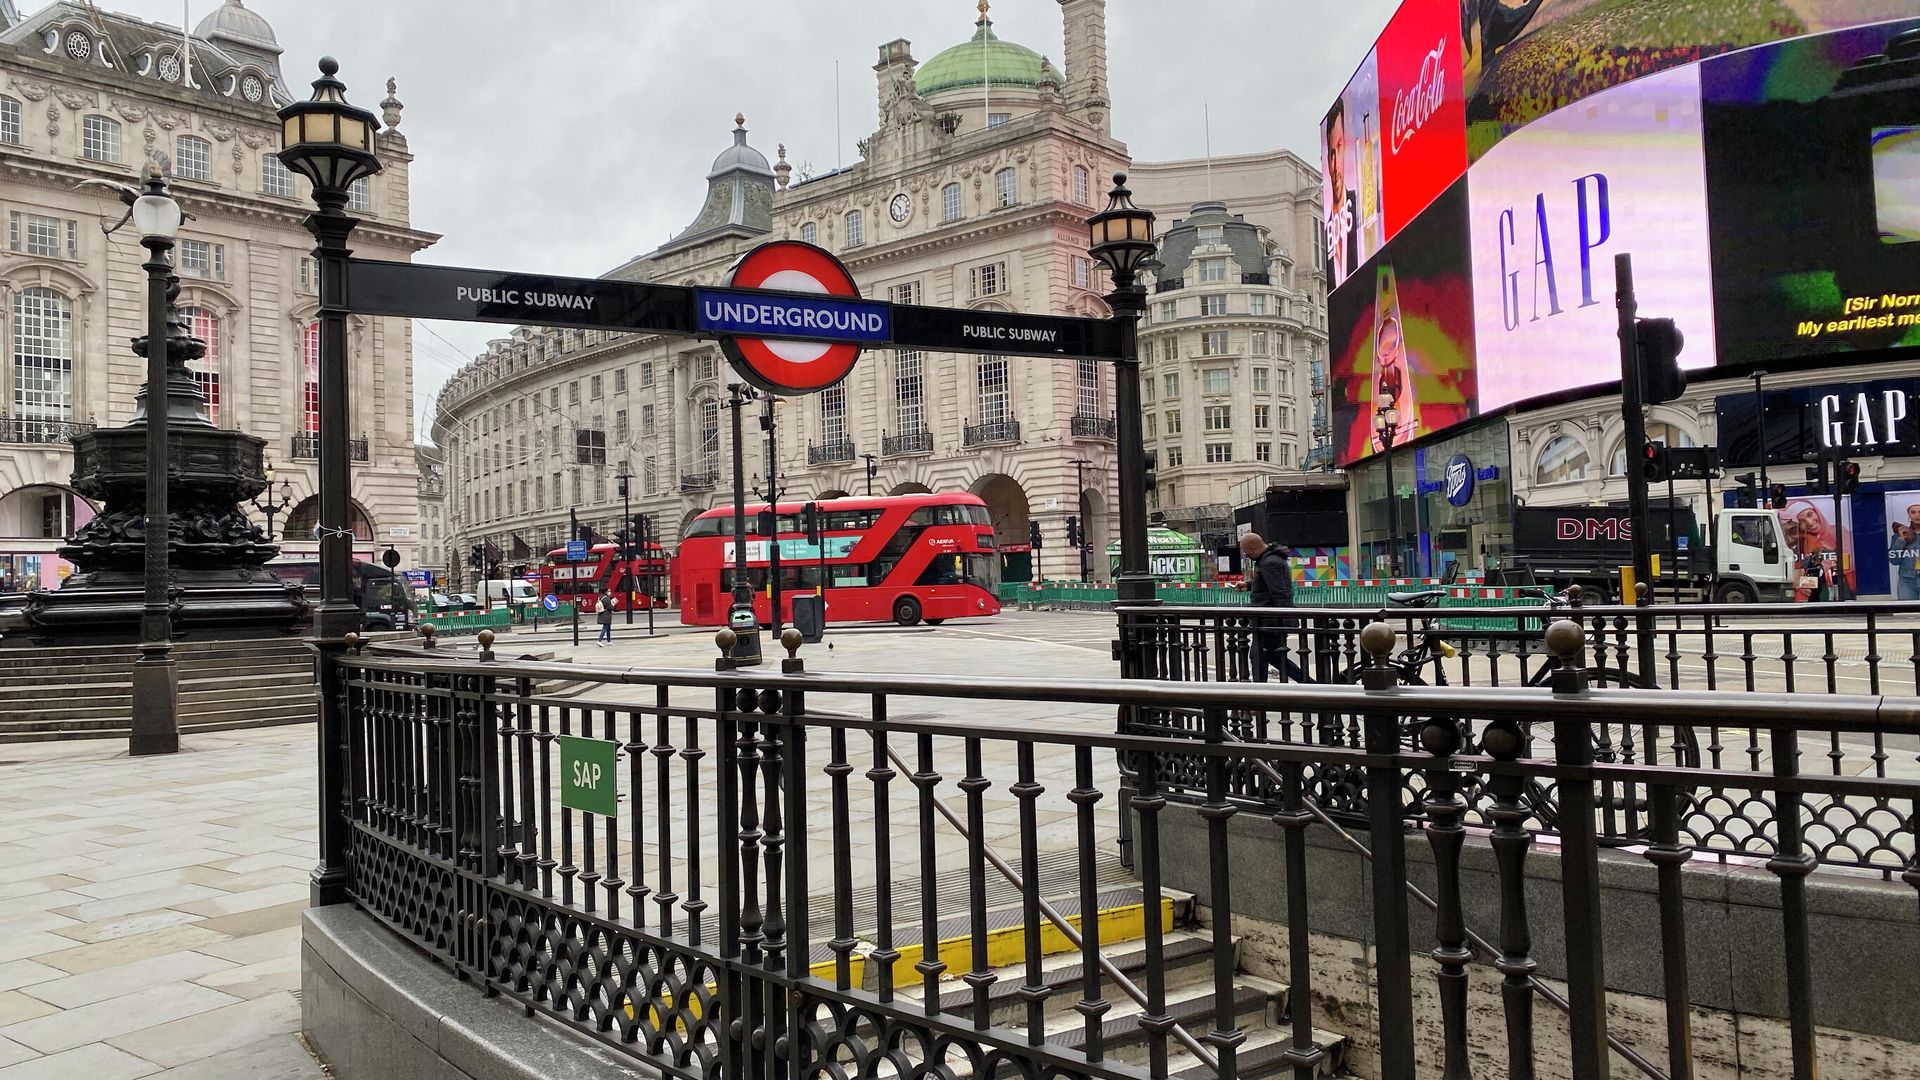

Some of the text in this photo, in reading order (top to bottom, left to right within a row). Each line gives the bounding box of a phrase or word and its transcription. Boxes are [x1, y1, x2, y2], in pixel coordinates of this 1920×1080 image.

[1391, 33, 1447, 155] Coca-Cola
[1327, 199, 1353, 252] BOSS
[1499, 173, 1610, 331] GAP
[456, 286, 594, 310] PUBLIC SUBWAY
[1844, 296, 1879, 315] [Sir
[705, 300, 883, 332] UNDERGROUND
[1797, 320, 1824, 337] My
[1826, 313, 1895, 332] earliest
[963, 325, 1057, 342] PUBLIC SUBWAY
[1821, 390, 1906, 447] GAP
[1446, 462, 1467, 499] Boots
[1557, 517, 1633, 541] DMS
[573, 760, 602, 790] SAP
